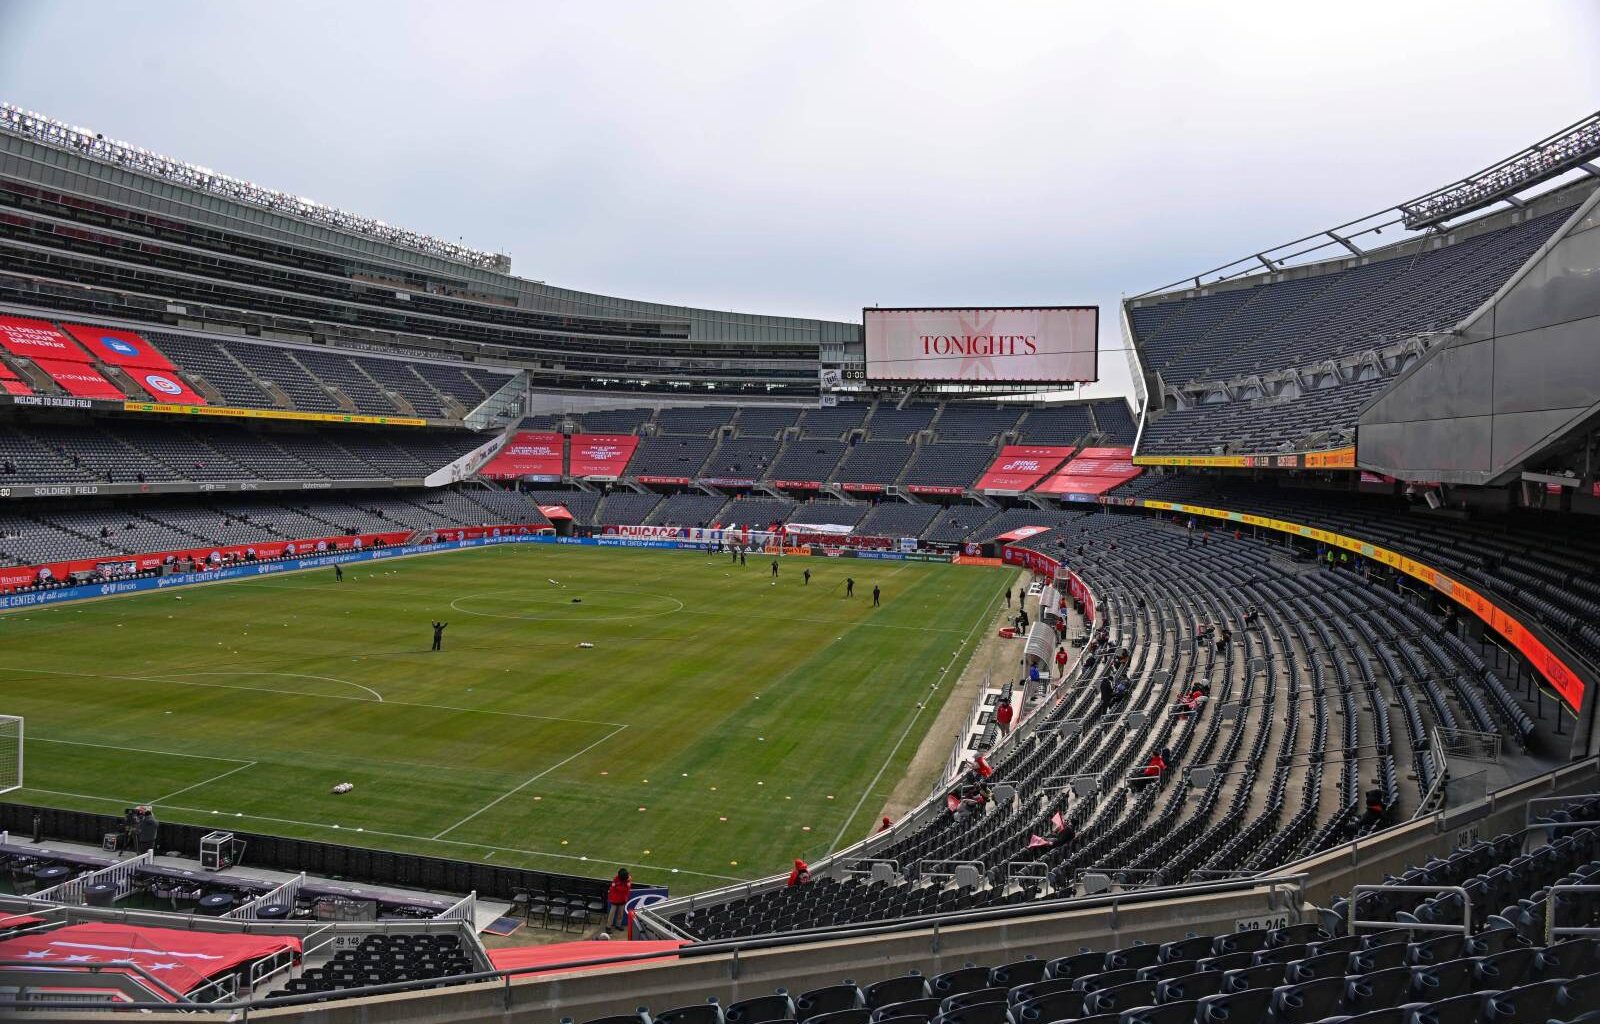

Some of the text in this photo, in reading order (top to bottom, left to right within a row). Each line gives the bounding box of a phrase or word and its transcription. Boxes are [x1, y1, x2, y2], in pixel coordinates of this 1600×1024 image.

[920, 335, 1037, 356] TONIGHT'S
[846, 371, 864, 380] 0:00
[14, 396, 92, 408] WELCOME TO SOLDIER FIELD
[34, 486, 98, 496] SOLDIER FIELD
[142, 558, 160, 566] xerox
[186, 574, 194, 582] THE
[195, 571, 213, 582] CENTER
[117, 582, 137, 592] Illinois
[10, 595, 36, 606] CENTER
[36, 592, 46, 603] of
[46, 590, 57, 600] all
